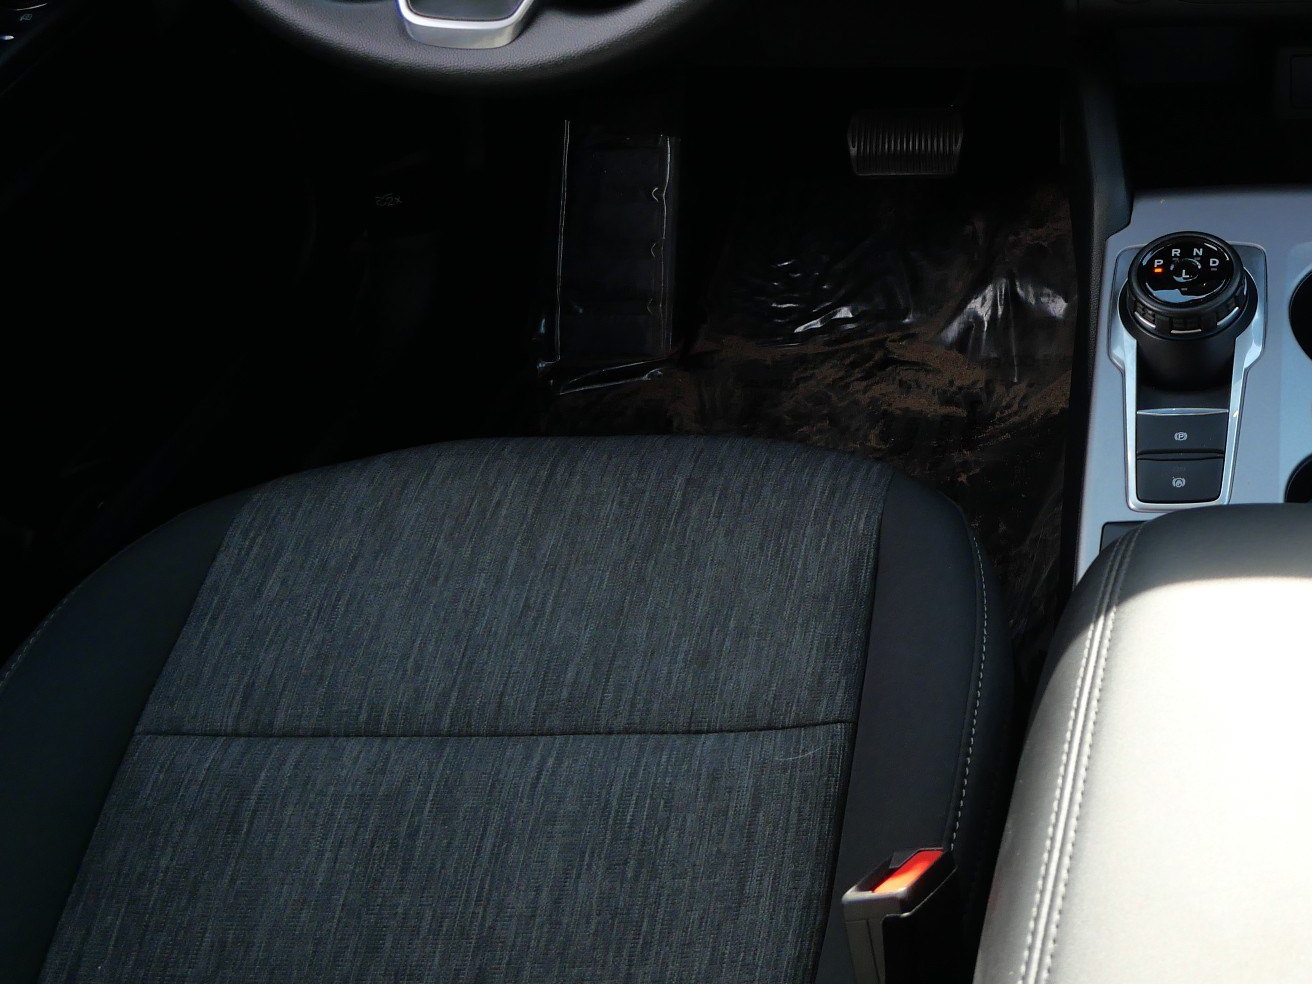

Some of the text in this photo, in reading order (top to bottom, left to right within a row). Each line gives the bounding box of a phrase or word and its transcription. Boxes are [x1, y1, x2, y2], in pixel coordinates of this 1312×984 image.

[1171, 248, 1181, 257] R
[1193, 247, 1203, 256] N
[1154, 259, 1164, 268] P
[1209, 258, 1220, 267] D
[1181, 269, 1190, 278] L
